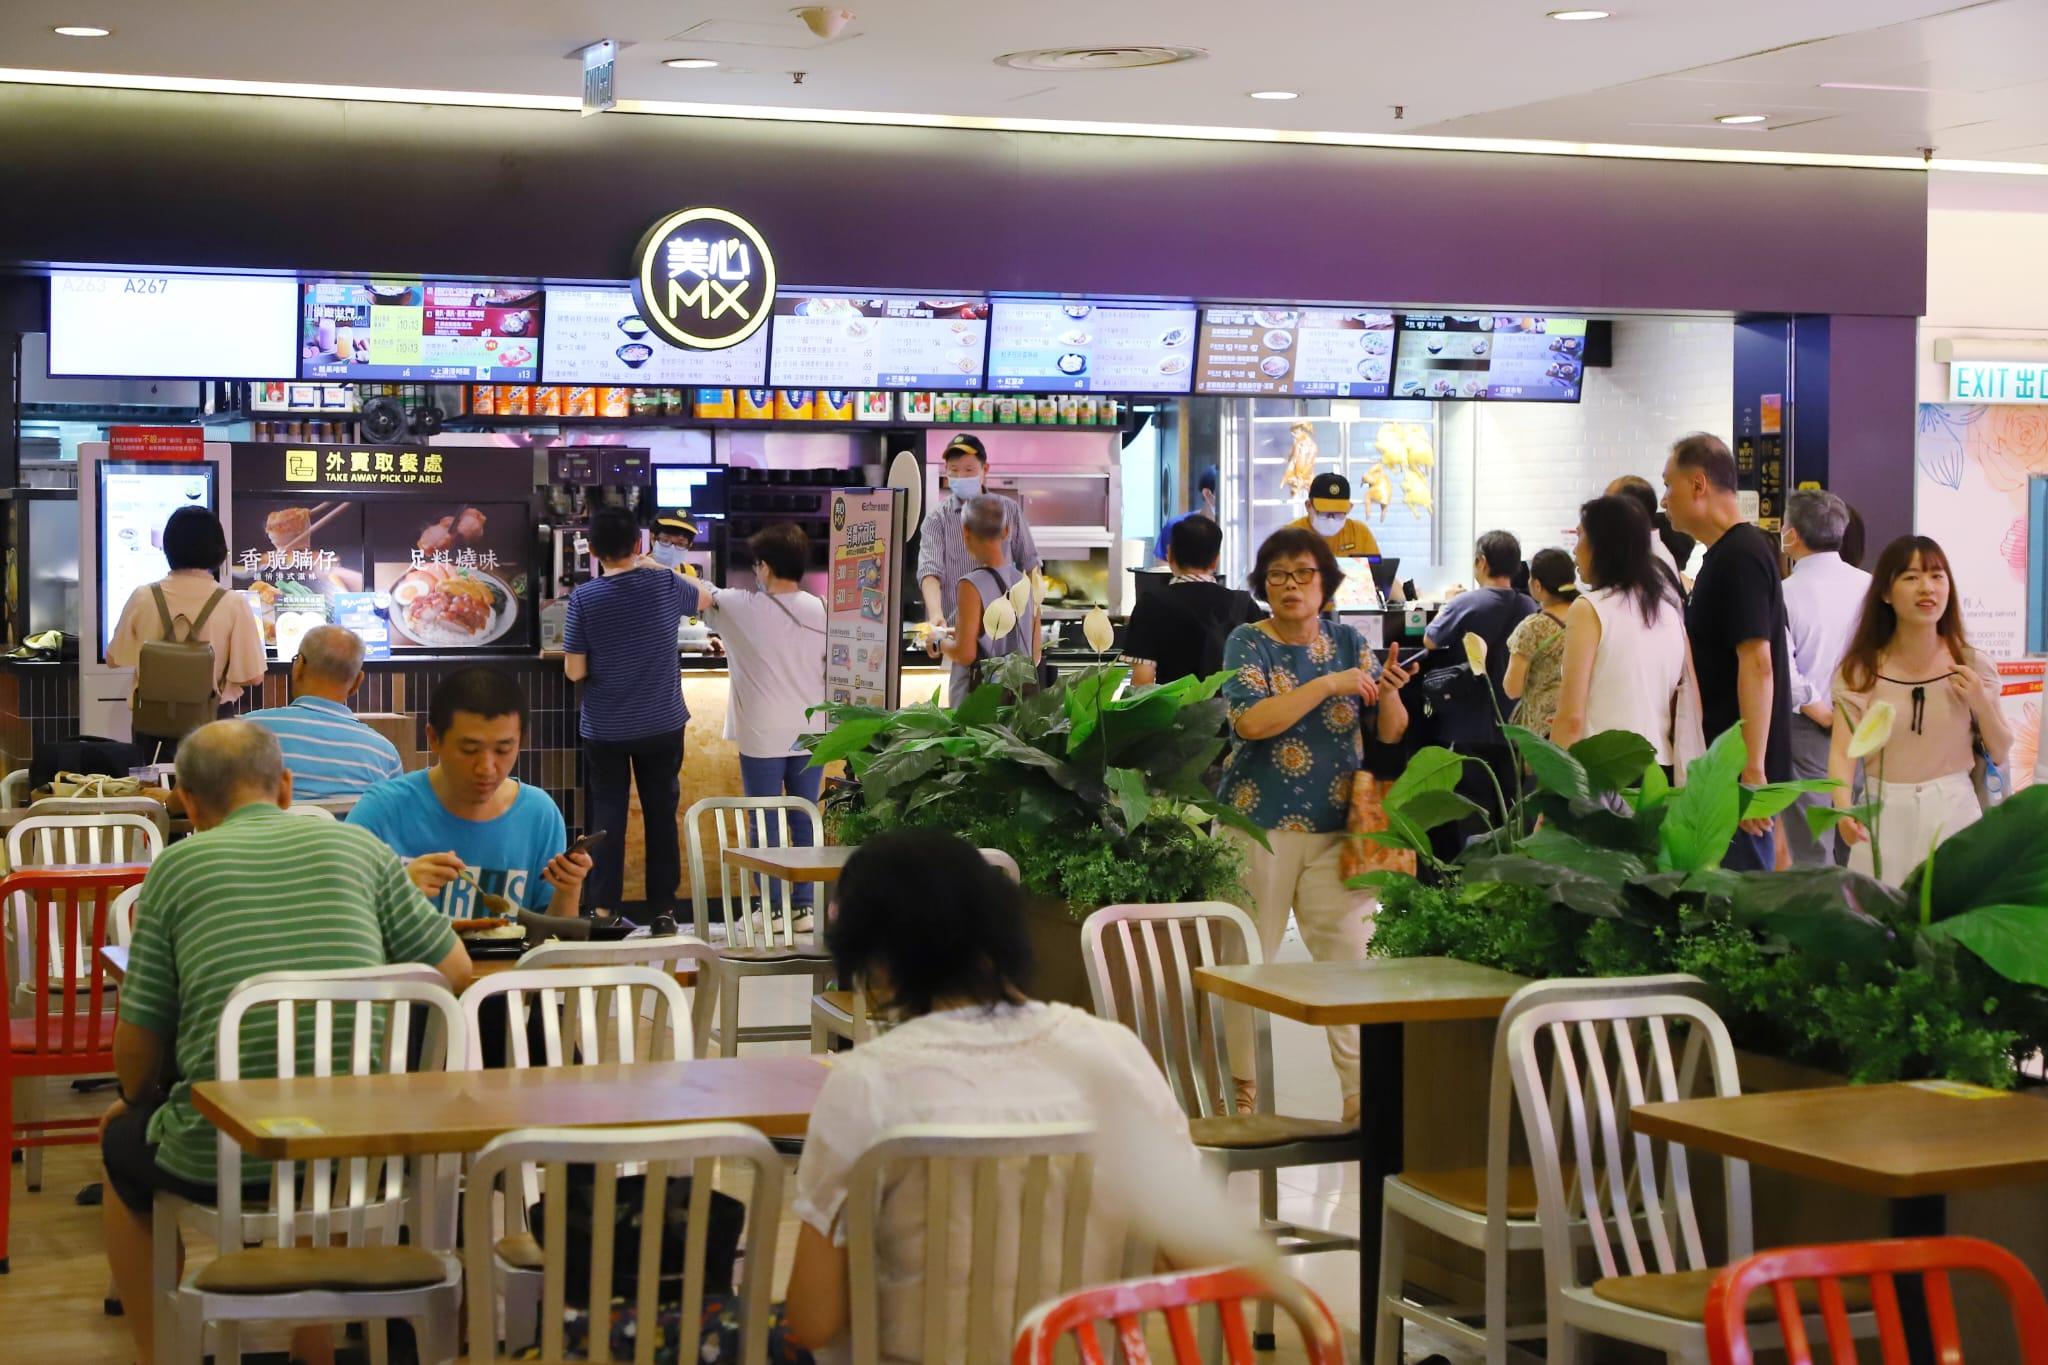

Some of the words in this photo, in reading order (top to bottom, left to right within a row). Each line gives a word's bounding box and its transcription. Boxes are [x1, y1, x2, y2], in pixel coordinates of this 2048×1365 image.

[667, 237, 751, 280] 美心
[123, 278, 168, 293] A267
[668, 278, 750, 320] MX
[1957, 367, 2009, 398] EXIT
[325, 451, 443, 474] 外賣取餐處
[325, 472, 348, 482] TAKE
[350, 472, 378, 483] AWAY
[380, 473, 402, 483] PICK
[403, 474, 417, 483] UP
[418, 474, 443, 484] AREA
[237, 548, 338, 572] 香脆腩仔
[406, 547, 500, 572] 足料燒味
